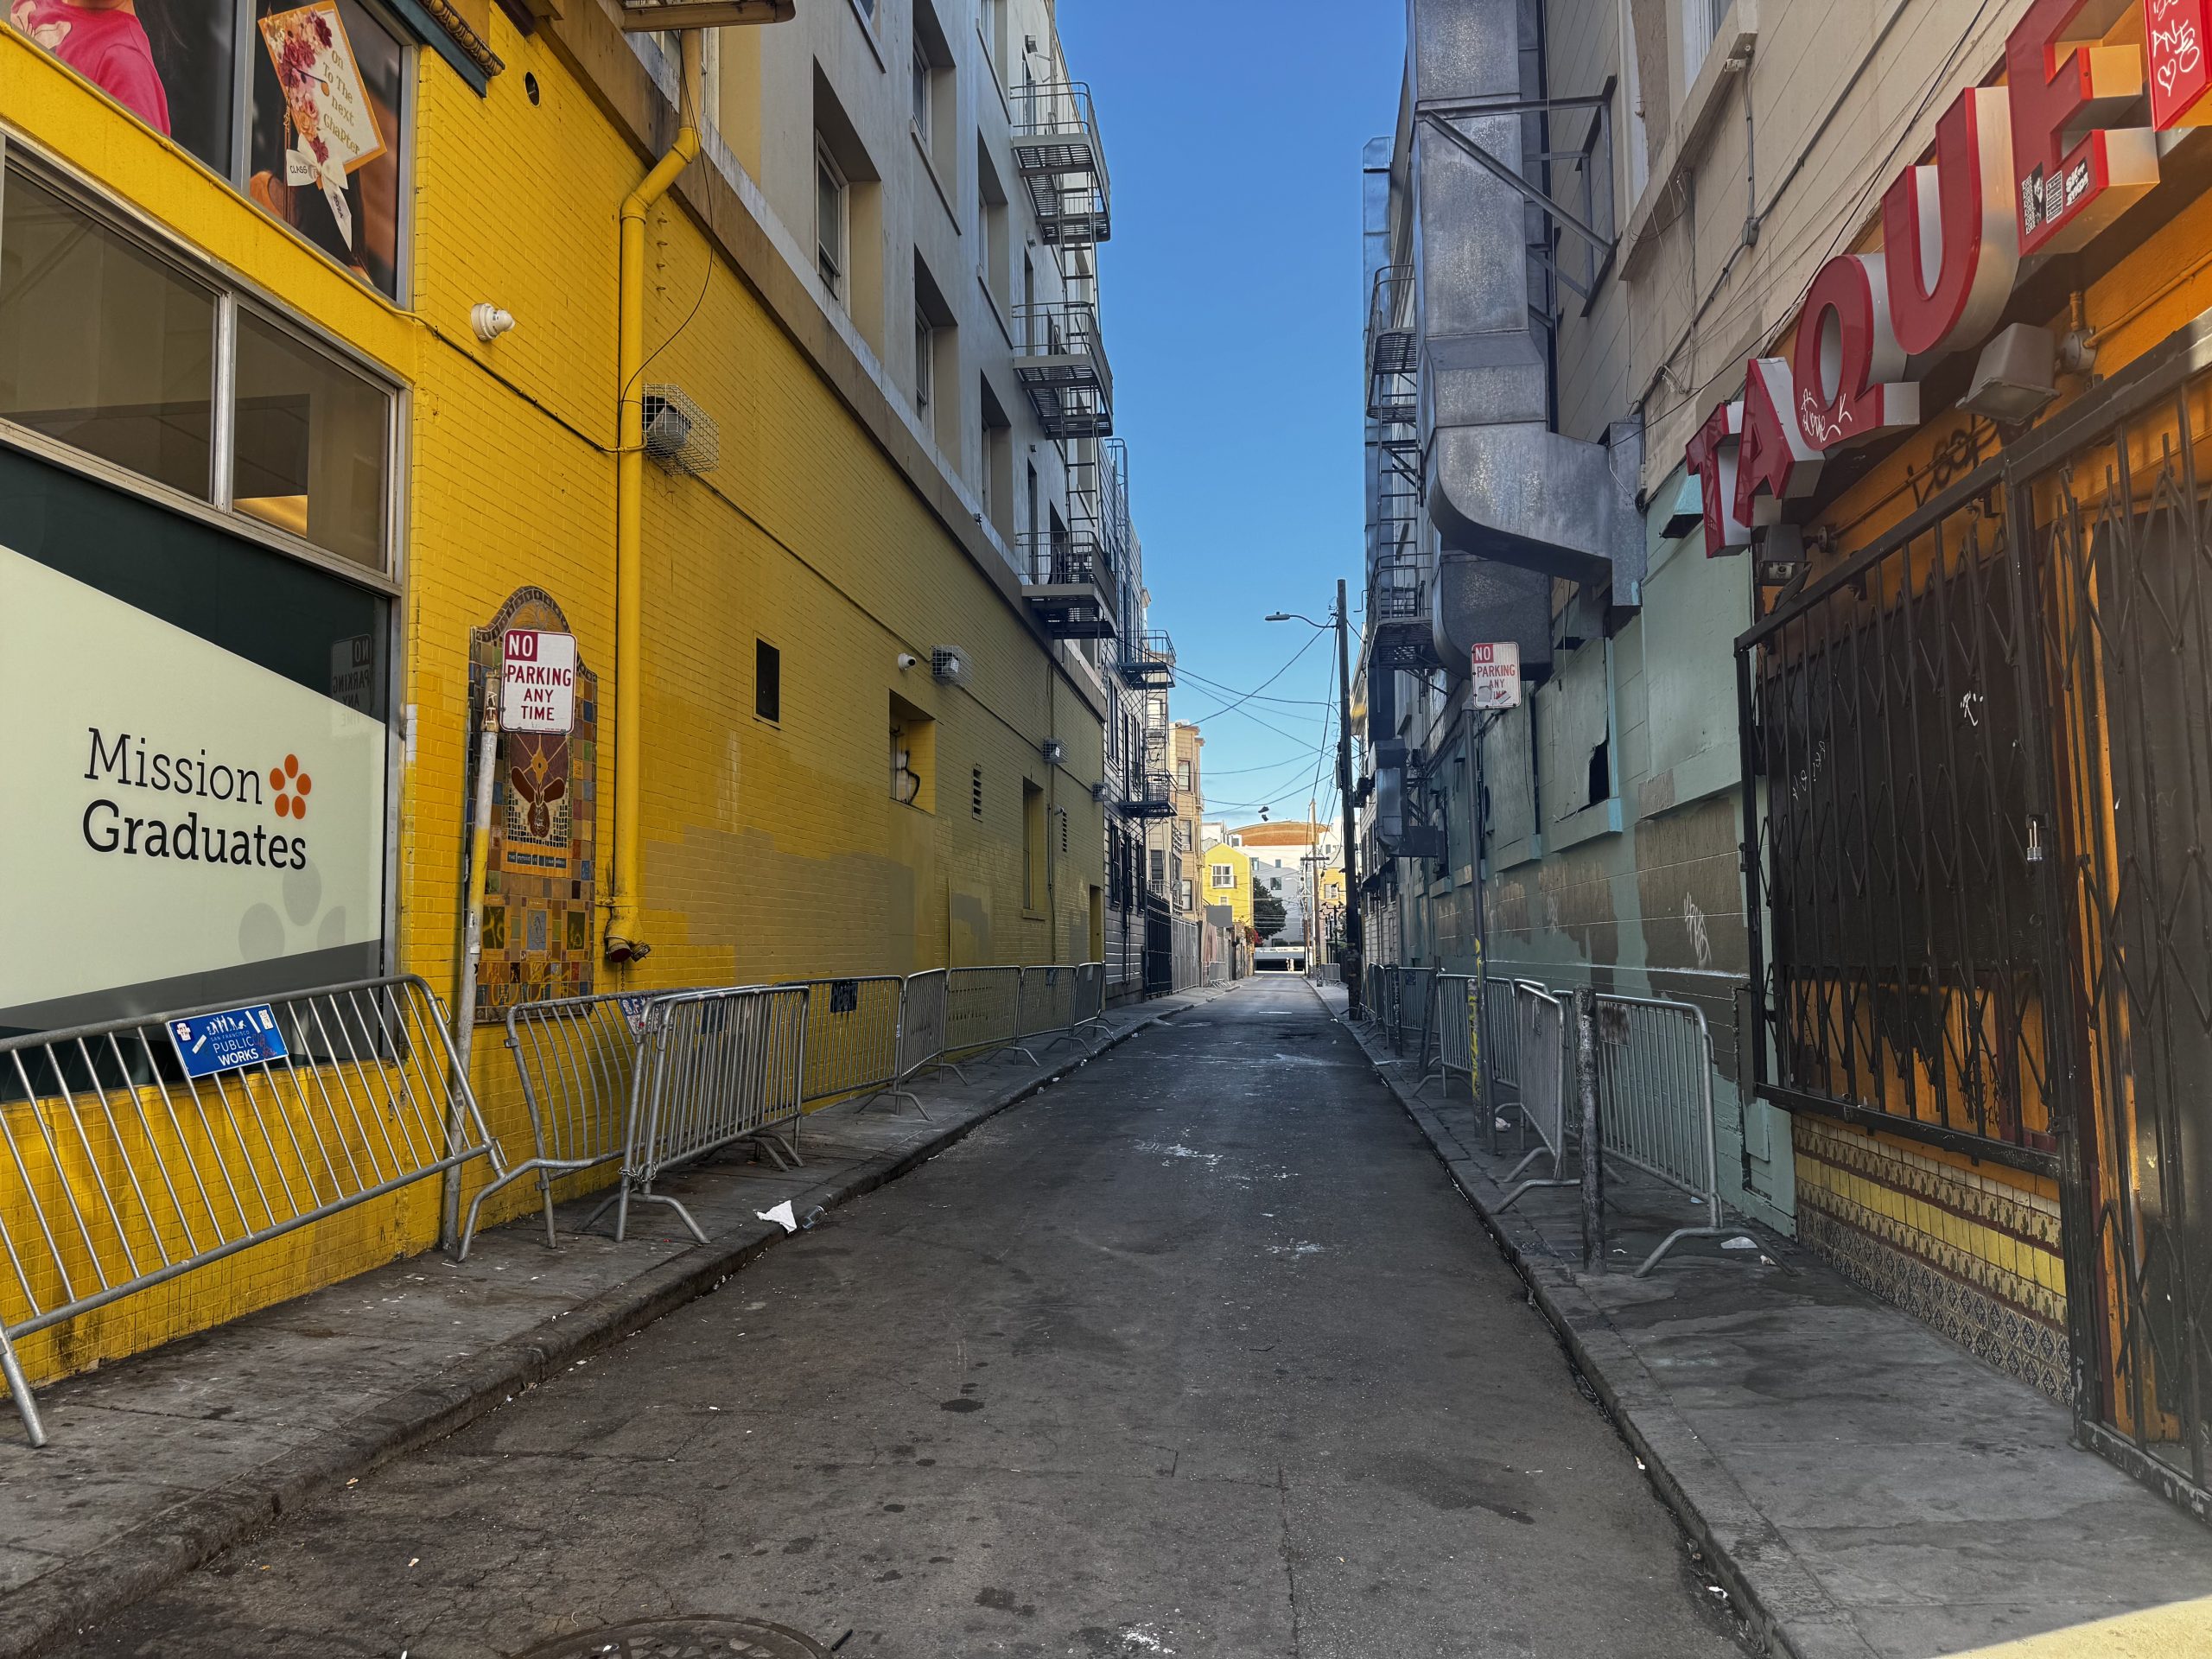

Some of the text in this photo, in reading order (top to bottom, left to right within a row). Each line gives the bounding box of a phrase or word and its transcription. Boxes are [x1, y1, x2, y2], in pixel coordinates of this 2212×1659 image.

[322, 61, 353, 105] To The
[331, 94, 355, 127] next
[290, 165, 308, 174] CLASS
[332, 193, 344, 219] 2024
[508, 634, 533, 658] NO
[1475, 646, 1491, 661] NO
[506, 664, 572, 687] PARKING
[1477, 664, 1516, 678] PARKING
[1489, 678, 1505, 689] ANY
[524, 688, 554, 703] ANY
[521, 705, 555, 721] TIME
[84, 727, 263, 805] Mission
[82, 798, 307, 870] Graduates
[222, 1030, 251, 1040] FRANCISCO
[213, 1036, 255, 1054] PUBLIC
[218, 1048, 259, 1066] WORKS
